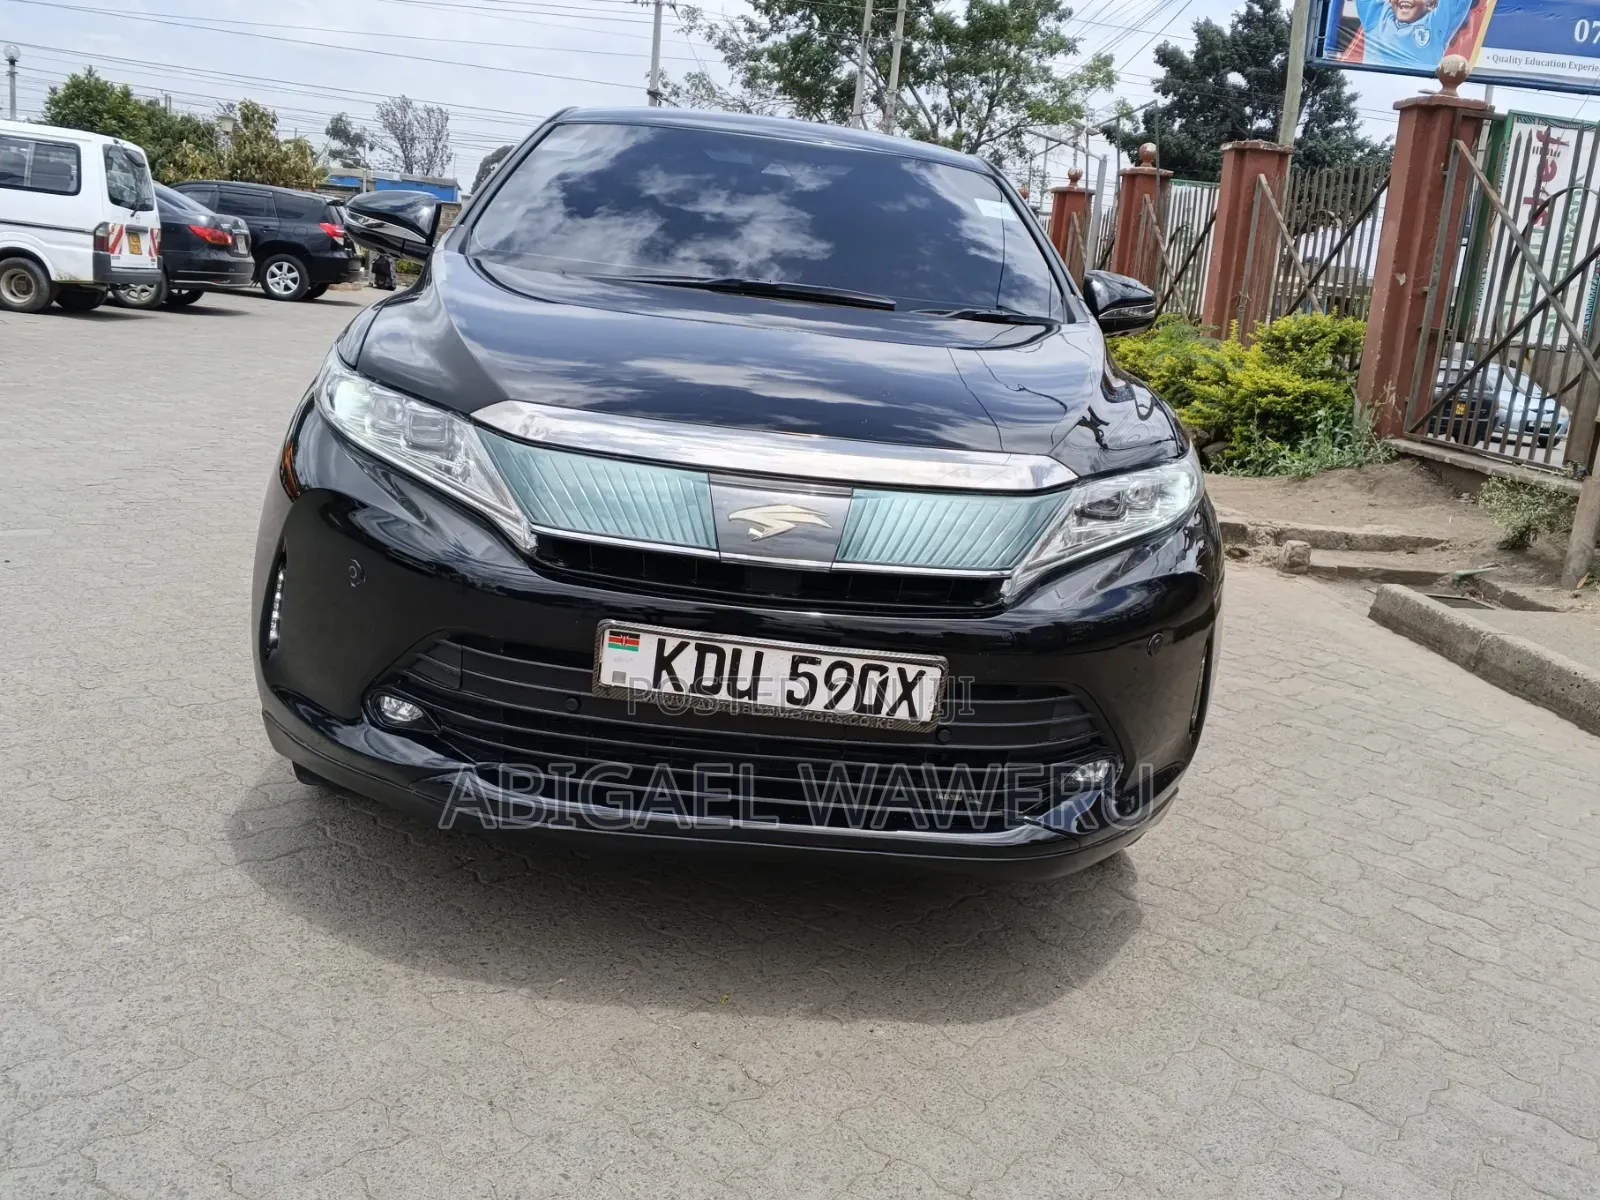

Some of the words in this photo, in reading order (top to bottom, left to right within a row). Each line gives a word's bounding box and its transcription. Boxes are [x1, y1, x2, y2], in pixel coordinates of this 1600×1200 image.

[1492, 54, 1523, 66] Quality
[1525, 57, 1567, 69] Education
[653, 637, 765, 702] KDU
[785, 654, 927, 719] 590X
